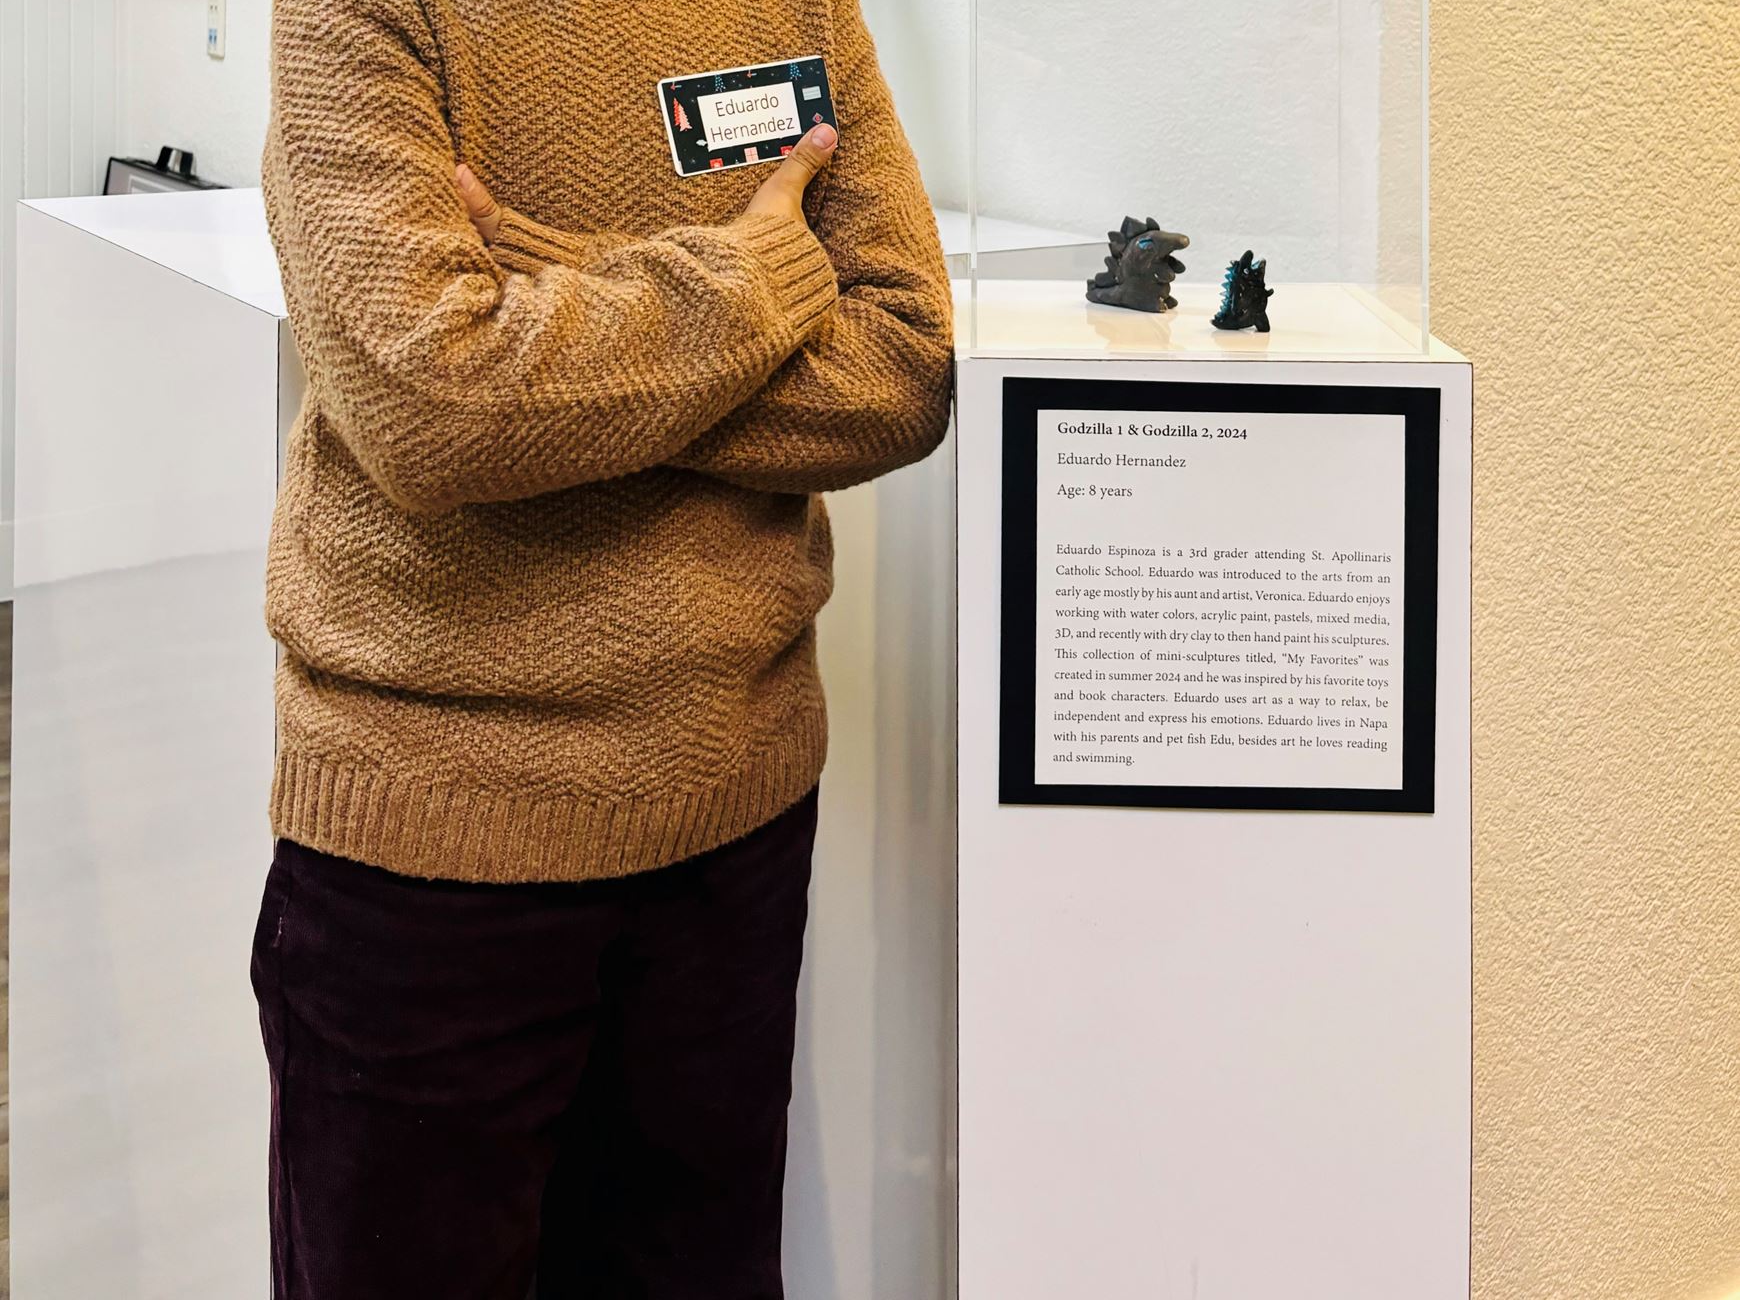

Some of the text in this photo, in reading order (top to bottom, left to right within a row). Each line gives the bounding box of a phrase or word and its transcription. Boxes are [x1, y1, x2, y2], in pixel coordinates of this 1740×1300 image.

[715, 93, 779, 117] Eduardo
[710, 115, 795, 143] Hernandez
[1058, 422, 1248, 440] Godzilla 1 & Godzilla 2, 2024
[1058, 452, 1187, 467] Eduardo Hernandez
[1057, 483, 1133, 500] Age: 8 years
[1057, 544, 1102, 555] Eduardo
[1109, 546, 1156, 559] Espinoza
[1190, 547, 1208, 559] 3rd
[1214, 547, 1249, 562] grader
[1255, 548, 1306, 563] attending
[1312, 550, 1325, 561] St.
[1332, 551, 1392, 565] Apollinaris
[1056, 565, 1101, 576] Catholic
[1105, 566, 1144, 577] School.
[1149, 567, 1194, 577] Eduardo
[1223, 569, 1281, 580] introduced
[1286, 572, 1297, 580] to
[1301, 570, 1318, 580] the
[1322, 573, 1343, 581] arts
[1347, 571, 1373, 583] from
[1056, 585, 1391, 607] early age mostly by his aunt and artist, Veronica. Eduardo enjoys
[1056, 607, 1390, 626] working with water colors, acrylic paint, pastels, mixed media,
[1055, 627, 1390, 648] 3D, and recently with dry clay to then hand paint his sculptures.
[1055, 648, 1078, 659] This
[1083, 648, 1135, 660] collection
[1140, 649, 1153, 661] of
[1157, 650, 1241, 664] mini-sculptures
[1246, 652, 1277, 663] titled,
[1369, 658, 1389, 666] was
[1055, 668, 1389, 690] created in summer 2024 and he was inspired by his favorite toys
[1054, 689, 1074, 701] and
[1079, 690, 1107, 700] book
[1111, 691, 1168, 702] characters.
[1174, 691, 1220, 703] Eduardo
[1225, 696, 1247, 704] uses
[1252, 696, 1267, 704] art
[1299, 698, 1320, 708] way
[1326, 698, 1336, 706] to
[1342, 696, 1371, 708] relax,
[1376, 697, 1389, 708] be
[1054, 710, 1388, 731] independent and express his emotions. Eduardo lives in Napa
[1054, 730, 1388, 752] with his parents and pet fish Edu, besides art he loves reading
[1053, 751, 1135, 766] and swimming.
